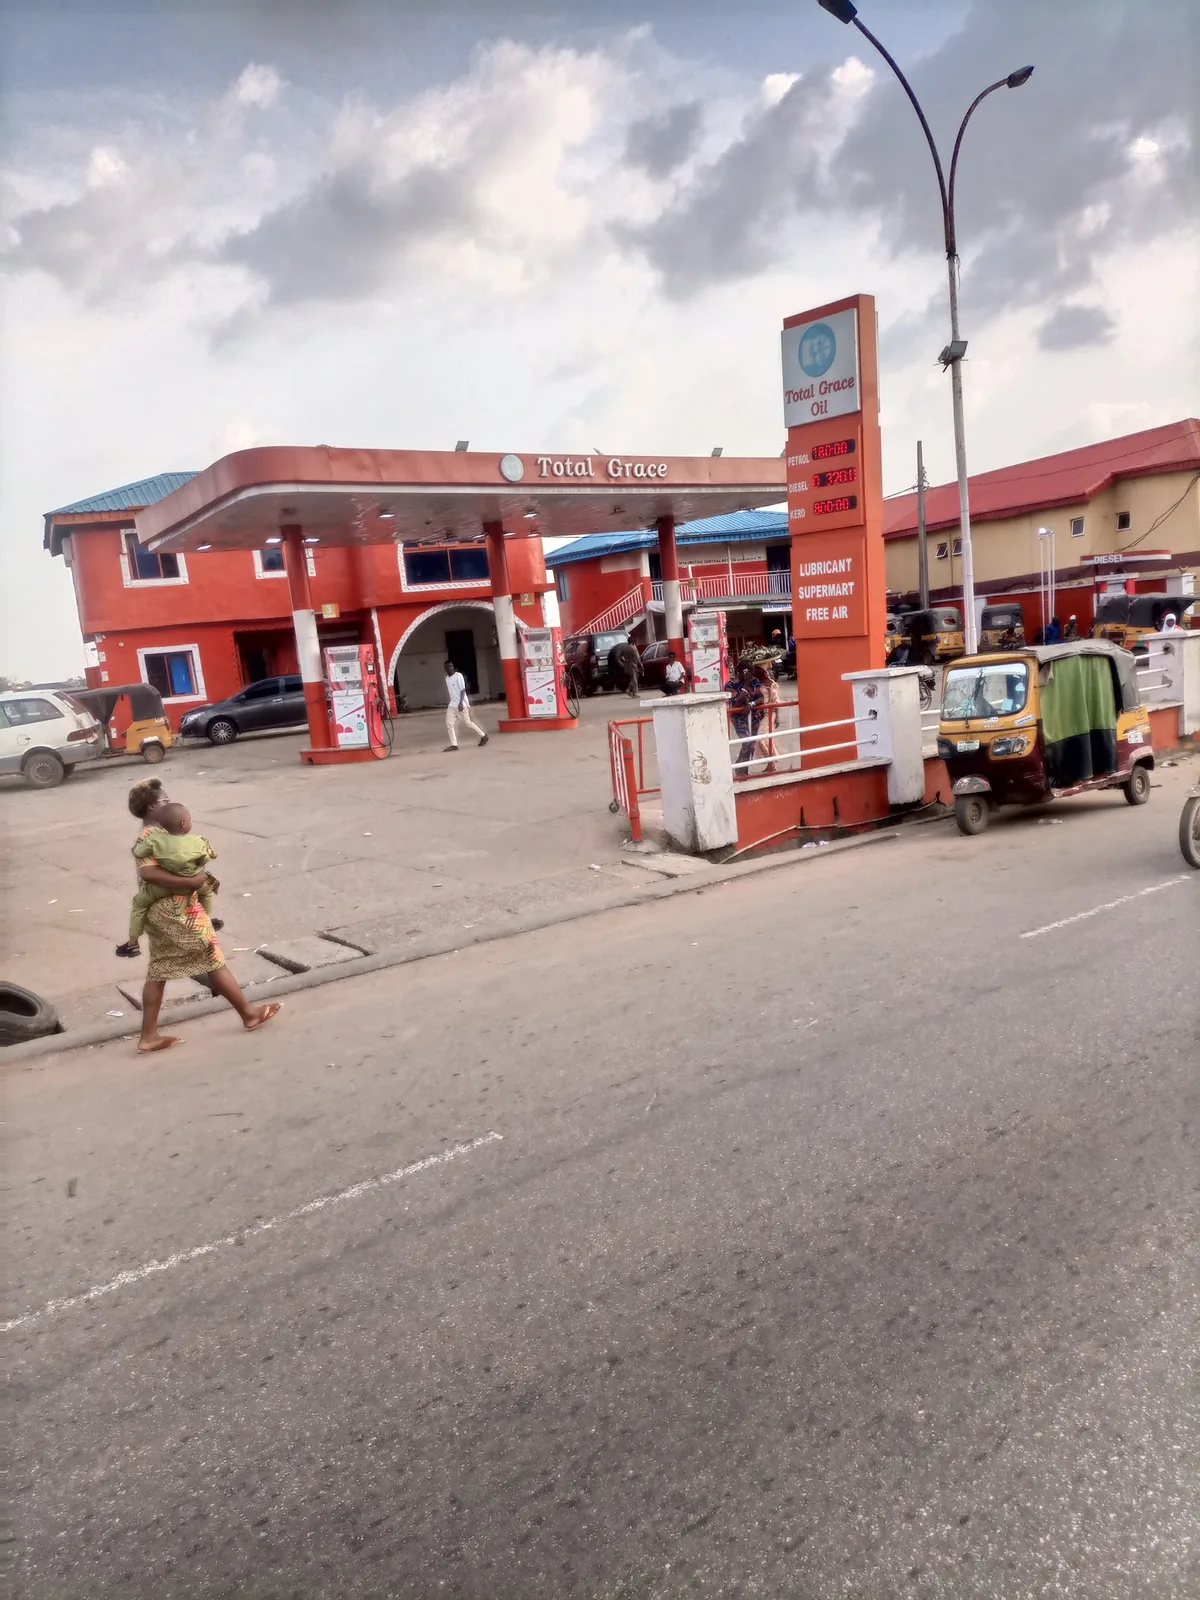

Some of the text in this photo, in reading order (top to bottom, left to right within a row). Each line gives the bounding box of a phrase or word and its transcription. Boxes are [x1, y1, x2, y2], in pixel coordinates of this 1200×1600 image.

[785, 377, 855, 404] Total Grace
[811, 400, 828, 416] Oil
[788, 453, 810, 467] PETROL
[537, 457, 668, 479] Total Grace
[789, 481, 808, 493] DIESEL
[790, 508, 806, 519] KERO
[1093, 554, 1124, 565] DIESEL
[800, 558, 852, 577] LUBRICANT
[523, 593, 530, 602] 2
[798, 582, 855, 599] SUPERMART
[326, 604, 333, 614] 3
[806, 605, 848, 621] FREE AIR
